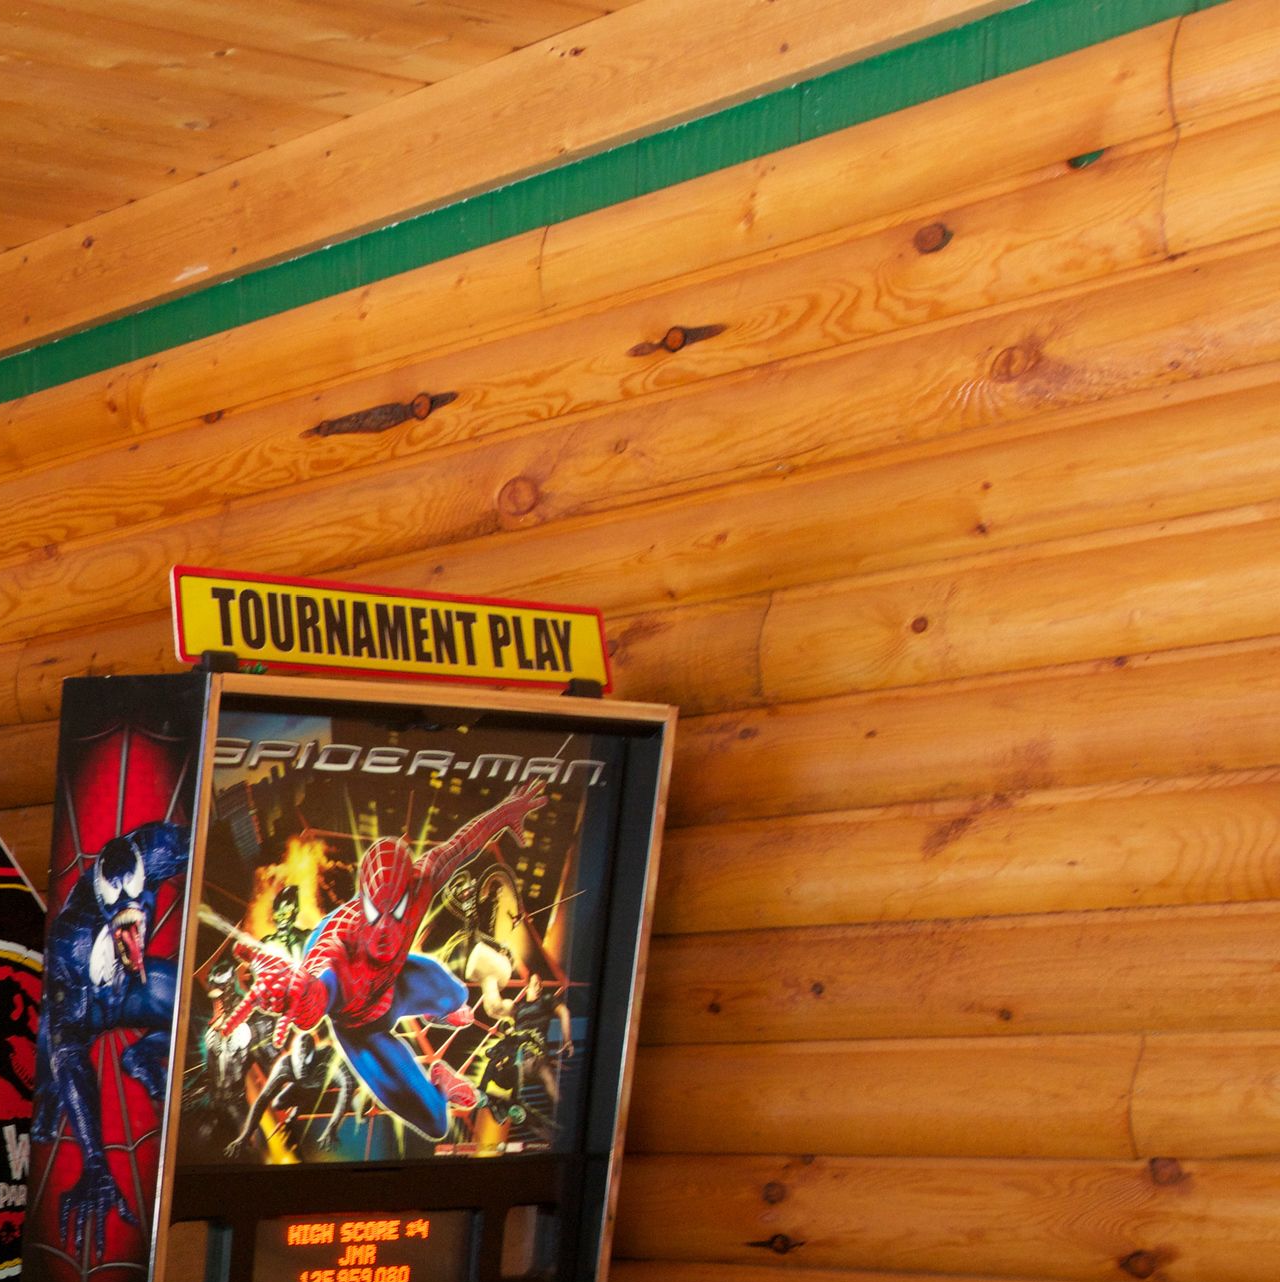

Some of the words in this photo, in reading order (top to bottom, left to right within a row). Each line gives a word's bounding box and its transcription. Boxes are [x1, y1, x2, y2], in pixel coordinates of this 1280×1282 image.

[211, 586, 477, 667] TOURNAMENT
[490, 613, 573, 673] PLAY
[213, 737, 606, 788] SPIDER-MAN
[287, 1222, 335, 1245] HIGH
[340, 1220, 401, 1243] SCORE
[405, 1218, 430, 1239] #4
[338, 1244, 378, 1266] JMR
